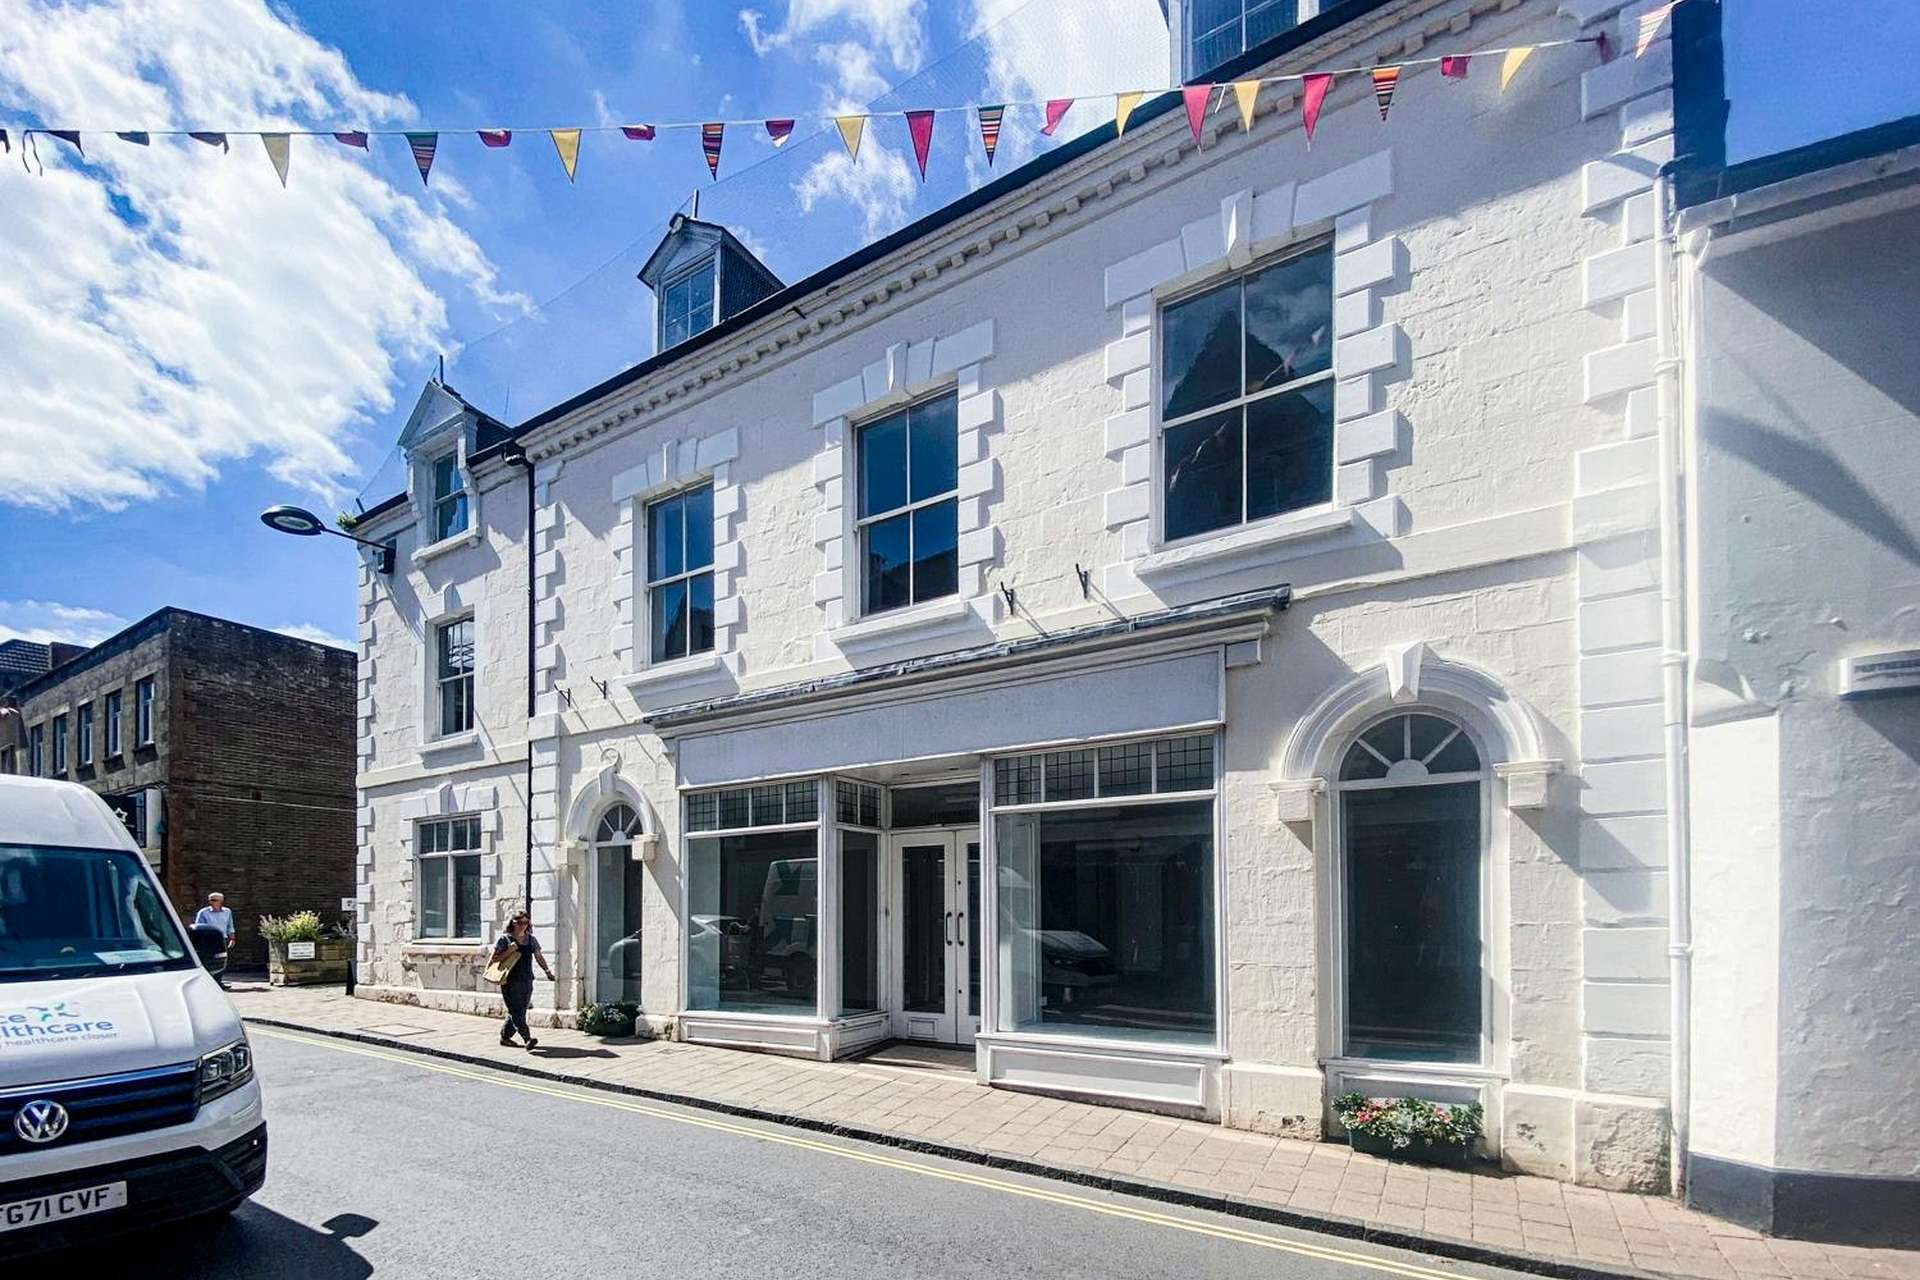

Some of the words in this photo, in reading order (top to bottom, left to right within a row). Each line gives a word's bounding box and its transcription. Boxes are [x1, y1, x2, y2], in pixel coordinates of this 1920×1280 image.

[5, 1035, 79, 1047] healthcare
[0, 1199, 50, 1224] G71
[59, 1187, 110, 1214] CVF
